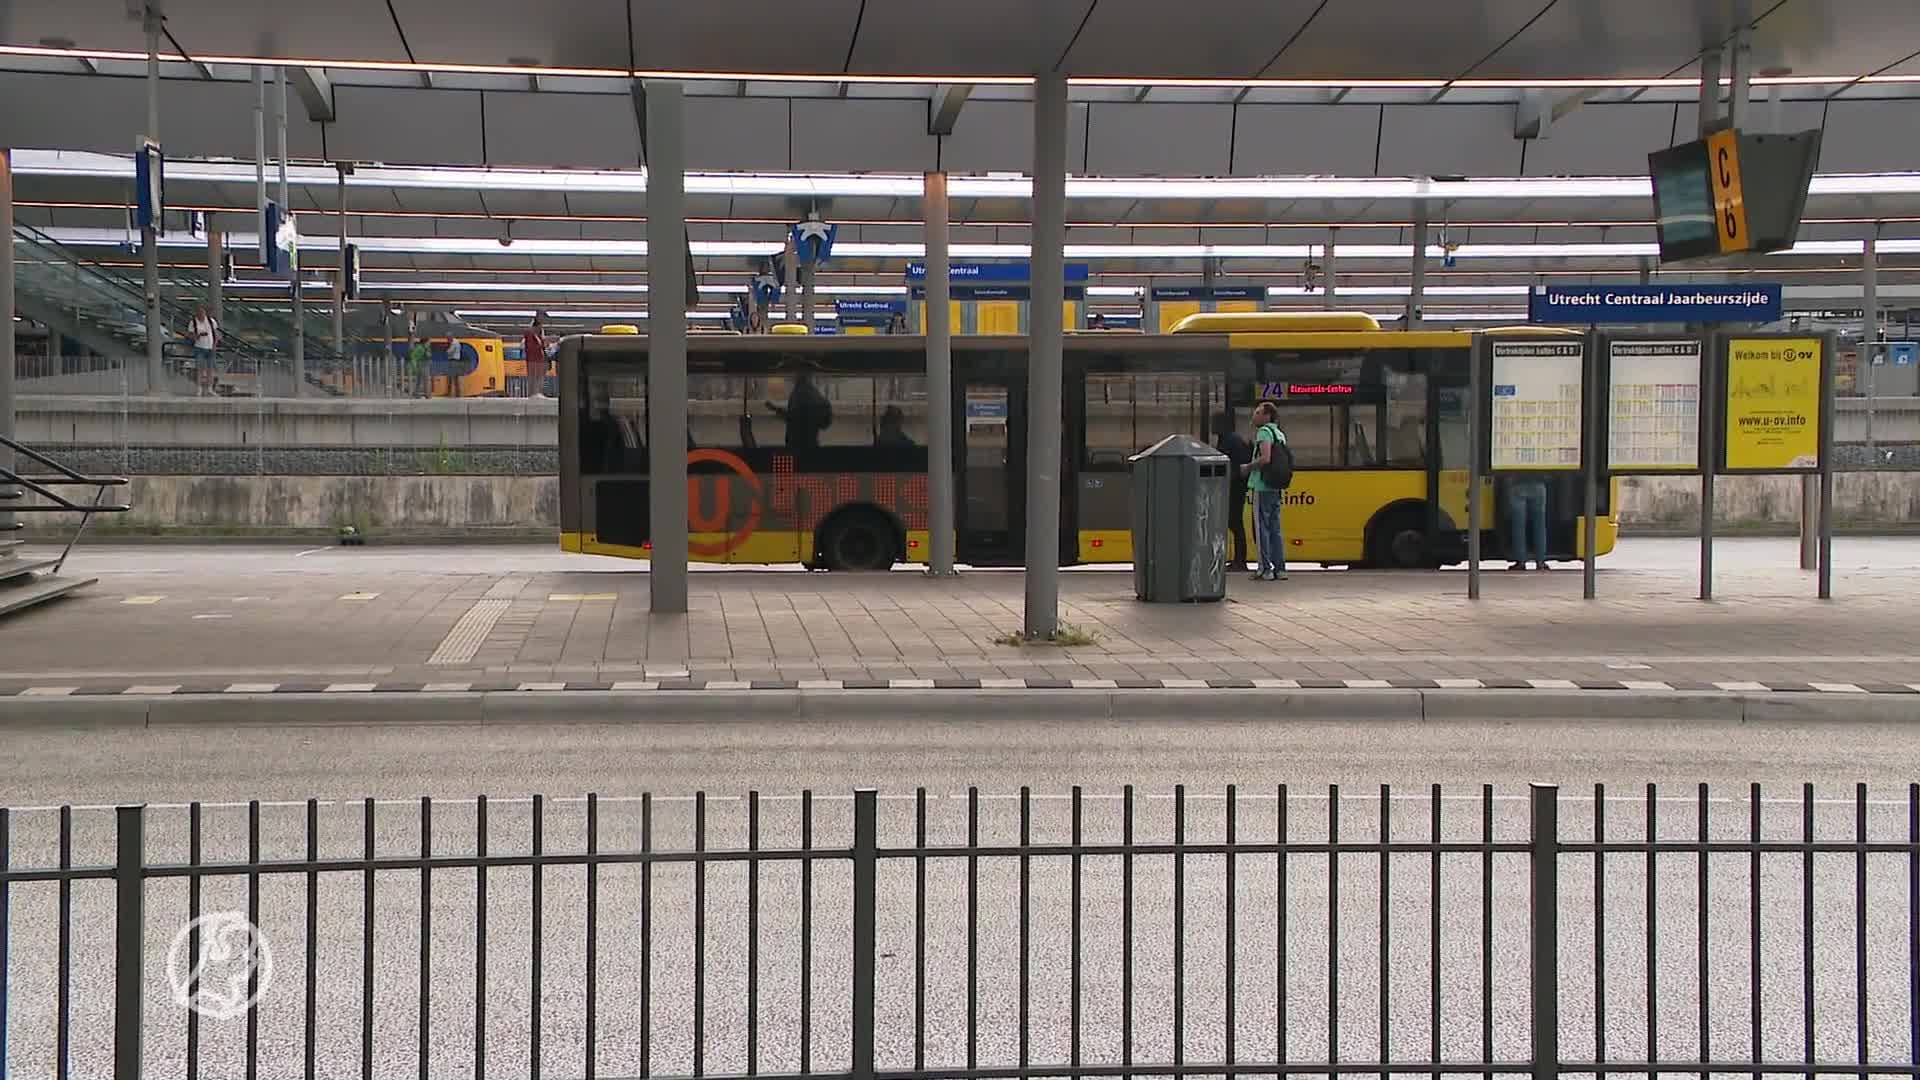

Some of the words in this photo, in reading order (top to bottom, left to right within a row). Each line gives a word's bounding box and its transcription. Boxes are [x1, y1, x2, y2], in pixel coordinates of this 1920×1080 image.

[1718, 147, 1730, 188] C
[1724, 199, 1737, 239] 6
[949, 266, 979, 275] entraal
[1550, 293, 1601, 305] Utrecht
[1605, 293, 1664, 305] Centraal
[1667, 292, 1769, 307] Jaarbeurszijde
[1735, 351, 1769, 360] Welkom
[1770, 351, 1781, 360] bij
[1798, 351, 1813, 359] ov
[1738, 414, 1807, 426] www.u-ov.info
